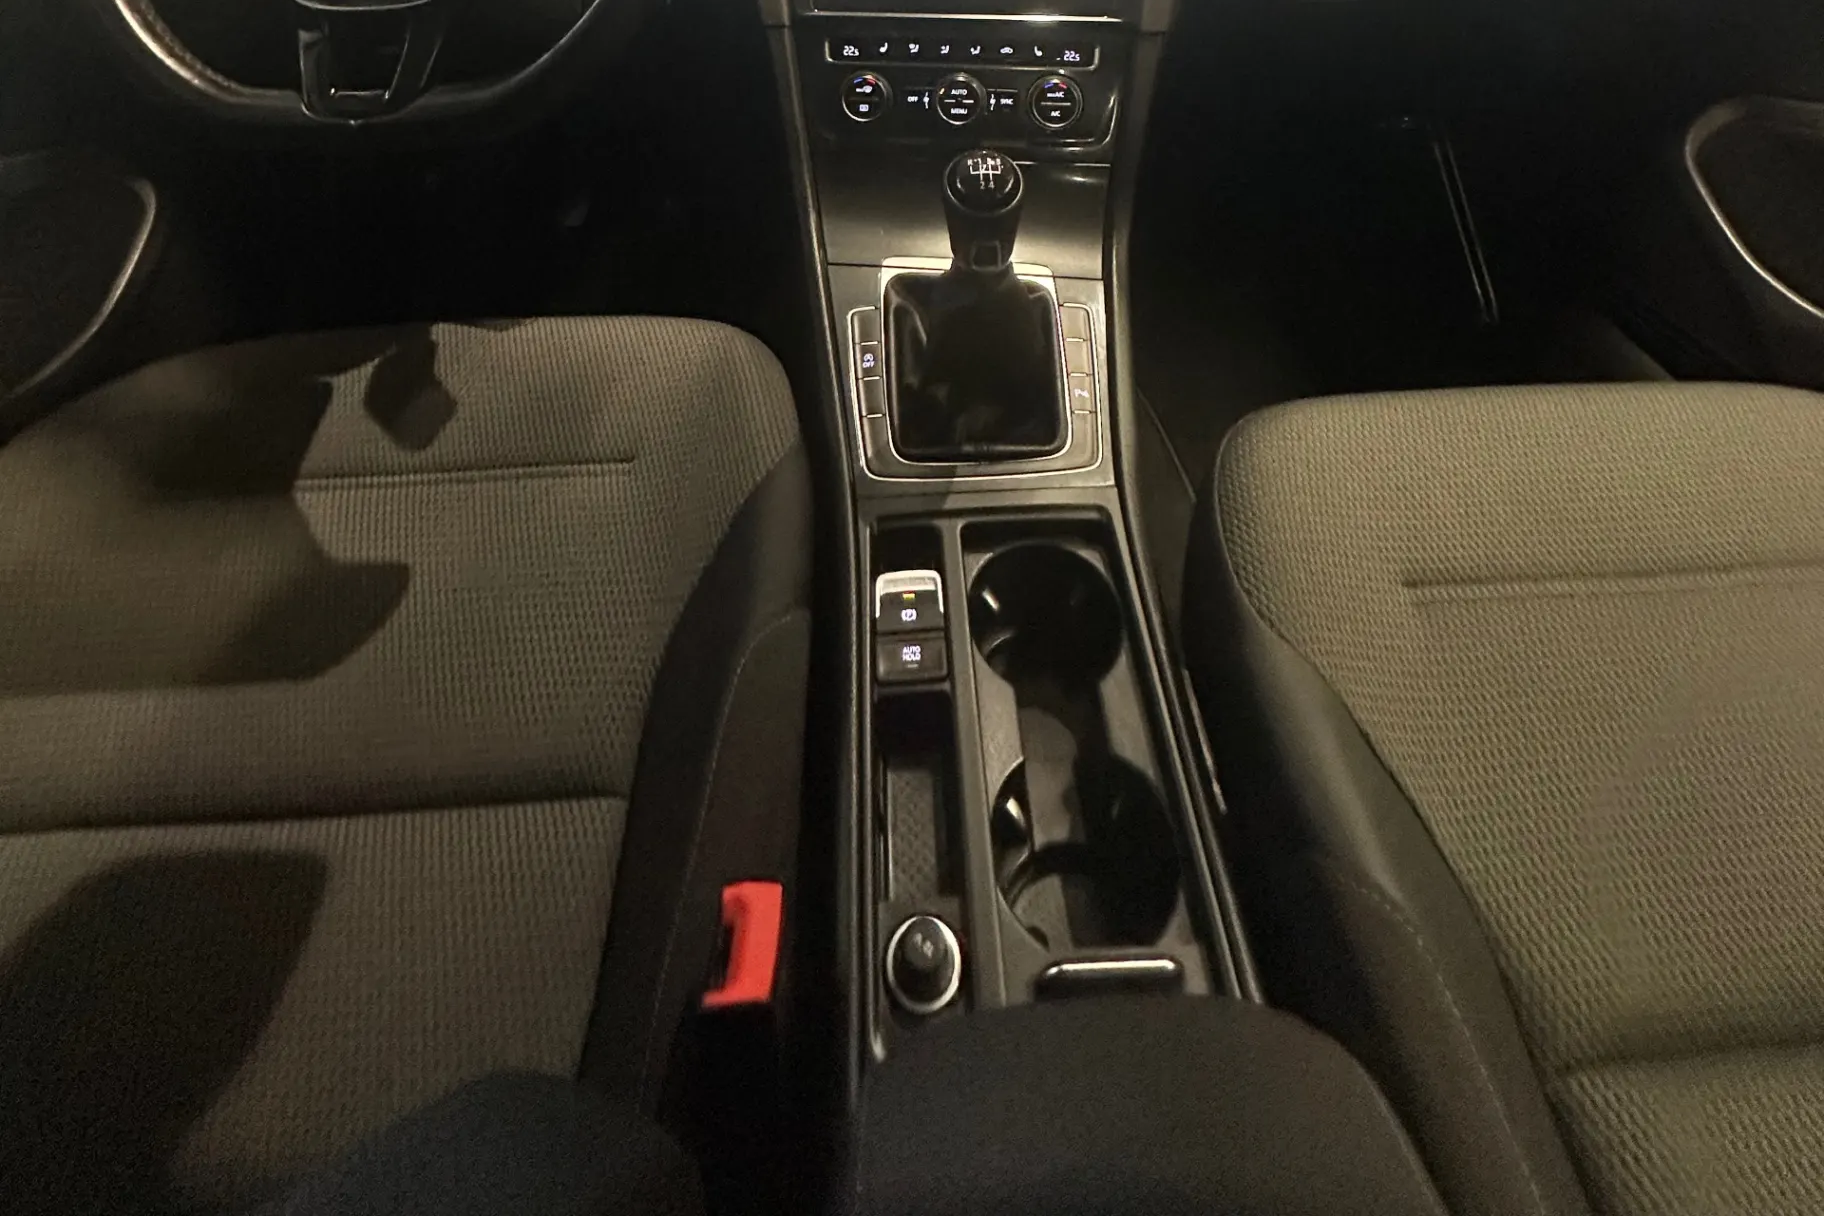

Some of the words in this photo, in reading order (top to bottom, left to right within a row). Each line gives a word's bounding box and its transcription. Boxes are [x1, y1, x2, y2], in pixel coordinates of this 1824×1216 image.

[950, 88, 968, 96] AUTO
[980, 181, 986, 190] 2
[988, 180, 995, 189] 4
[862, 360, 875, 368] OFF
[902, 645, 921, 653] AUTO
[902, 652, 921, 661] HOLD
